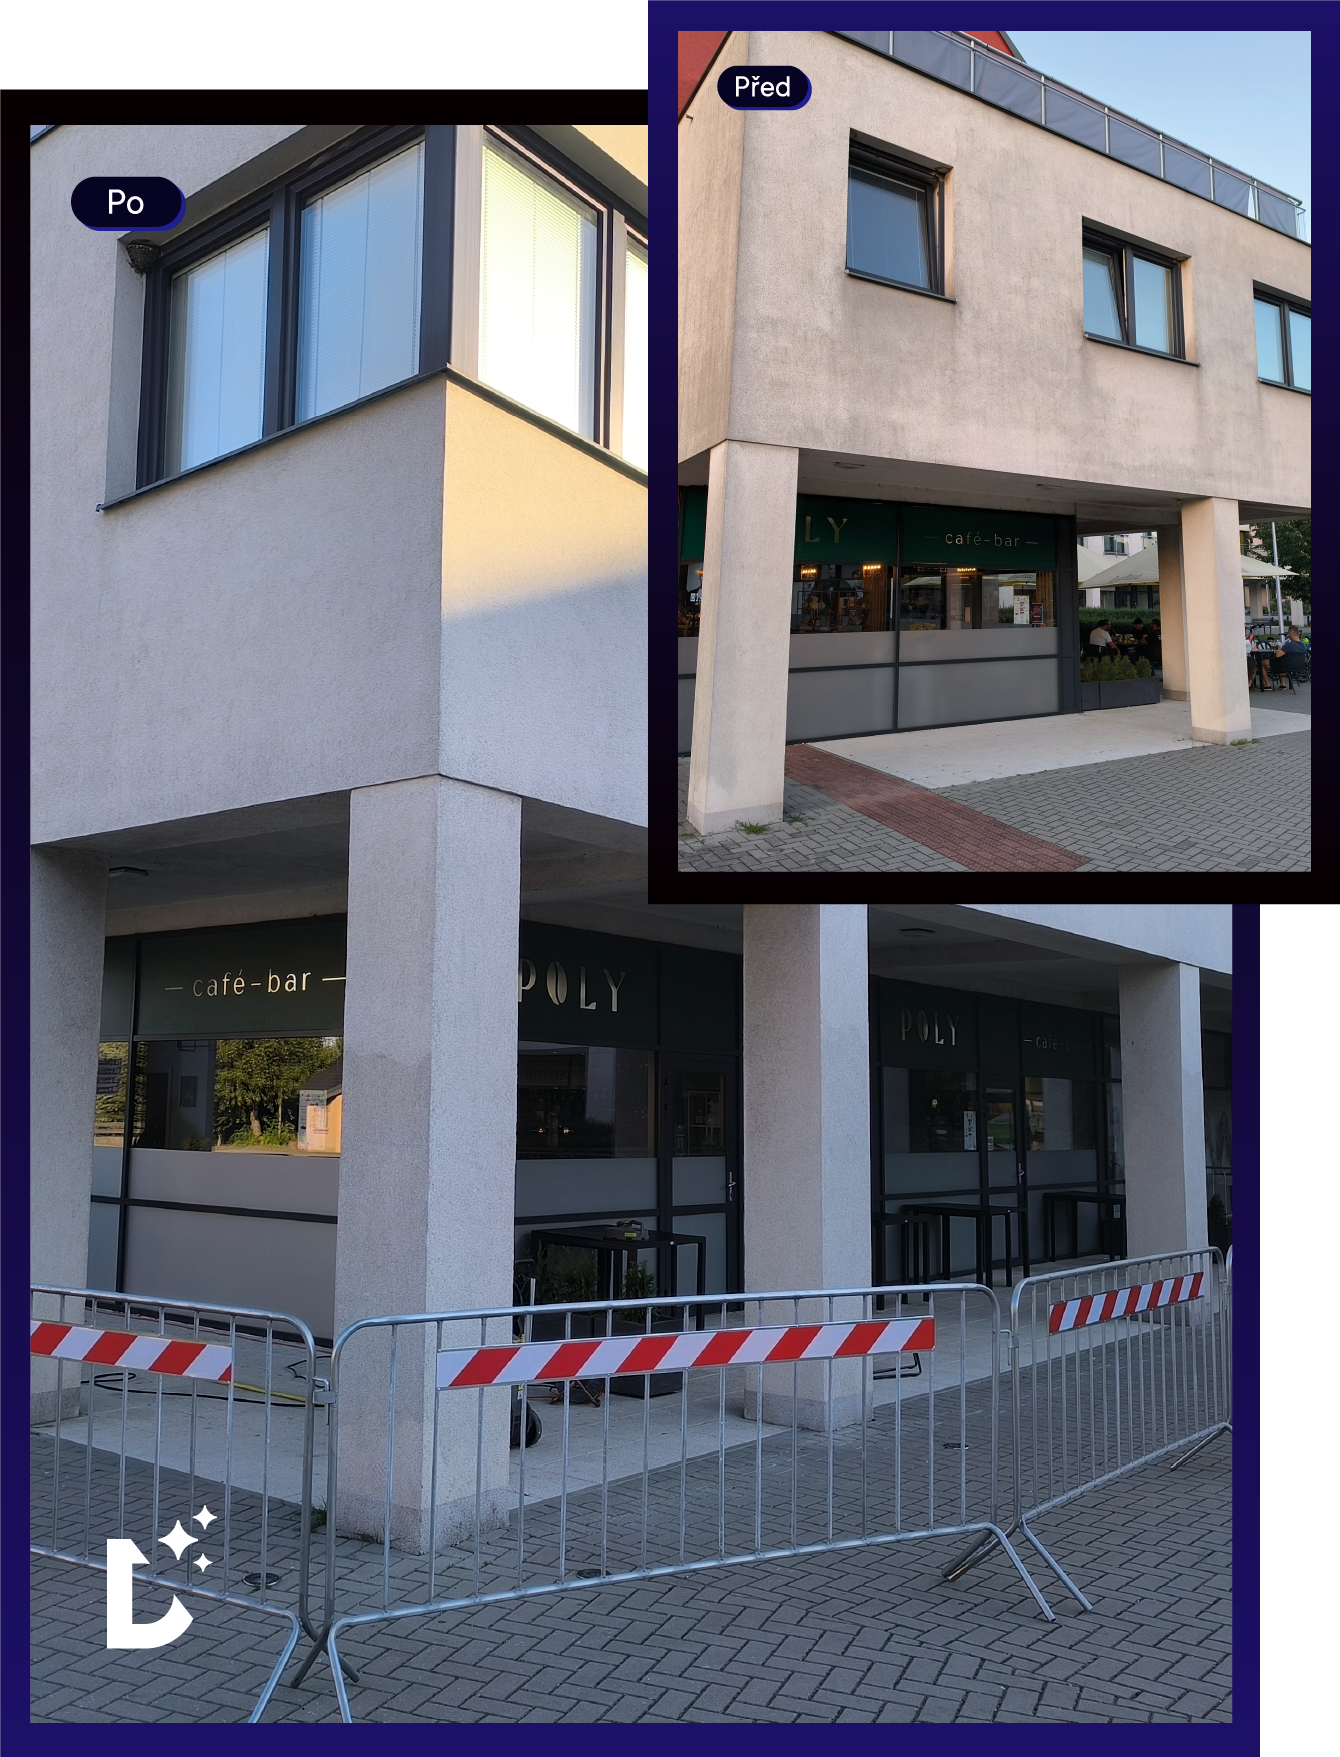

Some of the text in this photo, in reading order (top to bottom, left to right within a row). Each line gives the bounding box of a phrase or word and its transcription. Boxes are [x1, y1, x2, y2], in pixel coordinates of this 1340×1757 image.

[804, 515, 848, 543] LY
[945, 531, 1020, 547] café-bar
[192, 968, 311, 997] café-bar
[517, 957, 626, 1012] POLY
[901, 1009, 959, 1046] POLY
